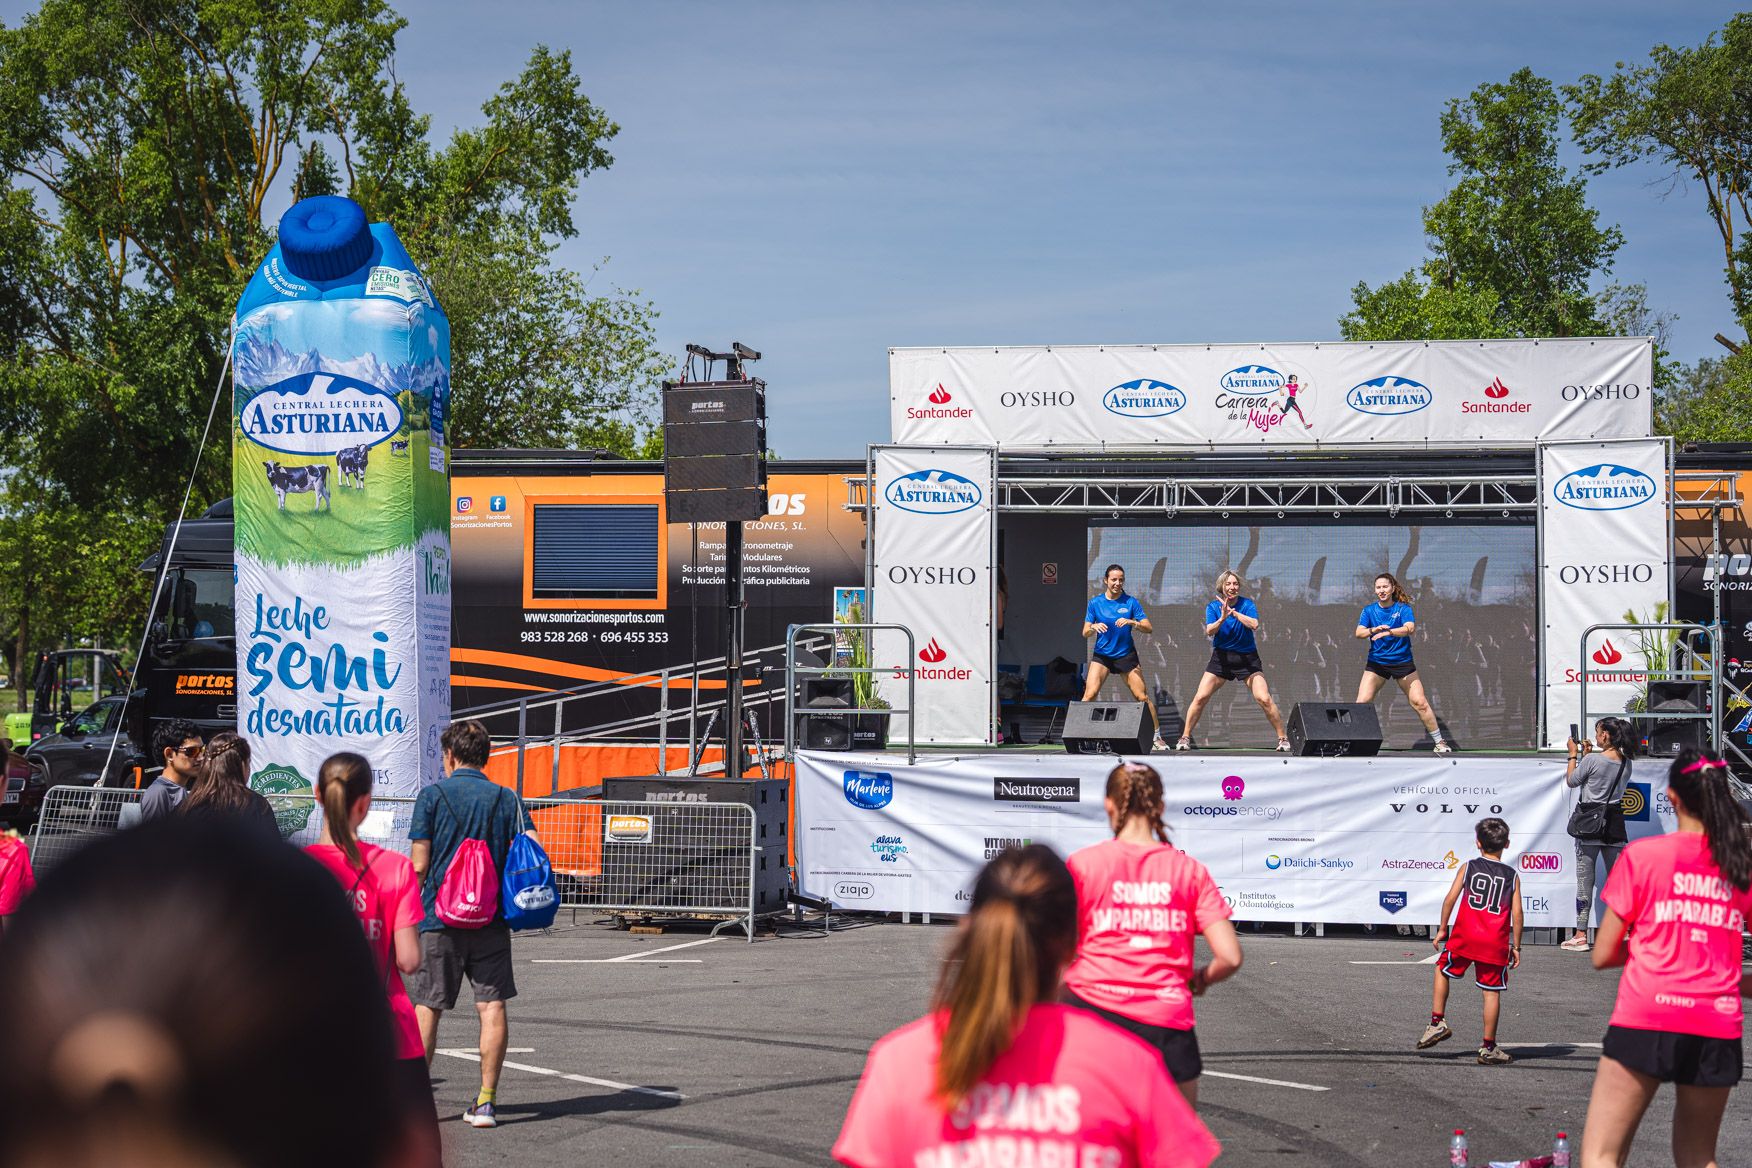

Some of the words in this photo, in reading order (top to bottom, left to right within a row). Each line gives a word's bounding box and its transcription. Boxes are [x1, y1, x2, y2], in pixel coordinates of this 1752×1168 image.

[372, 273, 400, 284] CERO
[1226, 376, 1280, 388] ASTURIANA
[1001, 391, 1075, 408] OYSHO
[1353, 391, 1425, 406] ASTURIANA
[1561, 384, 1640, 401] OYSHO
[273, 402, 325, 410] CENTRAL
[330, 400, 384, 409] LECHERA
[1110, 393, 1180, 408] ASTURIANA
[1215, 393, 1268, 409] Carrera
[1461, 401, 1532, 413] Santander
[249, 403, 391, 435] ASTURIANA
[907, 407, 974, 419] Santander
[1228, 410, 1238, 420] de
[1240, 410, 1247, 420] la
[1246, 407, 1288, 433] Mujer
[892, 484, 975, 503] ASTURIANA
[1561, 481, 1649, 499] ASTURIANA
[791, 522, 807, 530] SL.
[761, 563, 810, 573] Kilométricos
[888, 565, 976, 585] OYSHO
[1560, 563, 1653, 584] OYSHO
[765, 576, 810, 586] publicitaria
[250, 593, 330, 643] Leche
[523, 611, 665, 626] www.sonorizacionesportos.com
[520, 631, 542, 643] 983
[543, 631, 565, 643] 528
[567, 632, 589, 643] 268
[600, 632, 622, 643] 696
[624, 632, 645, 643] 455
[647, 632, 669, 643] 353
[247, 632, 402, 697] semi
[175, 674, 234, 689] portos
[247, 693, 409, 738] desnatada
[263, 787, 276, 795] SIN
[846, 779, 890, 800] Marlene
[1000, 781, 1074, 800] Neutrogena
[1393, 786, 1449, 795] VEHÍCULO
[1454, 787, 1498, 795] OFICIAL
[1183, 805, 1238, 818] octopus
[1239, 806, 1284, 821] energy
[1389, 803, 1503, 814] VOLVO
[611, 819, 648, 828] portos
[984, 838, 1022, 849] VITORIA
[881, 854, 897, 863] eus
[1284, 857, 1354, 871] Daiichi-Sankyo
[1381, 859, 1445, 870] AstraZeneca
[1521, 854, 1559, 870] COSMO
[1112, 880, 1172, 906] SOMOS
[1467, 872, 1506, 915] 91
[1673, 872, 1733, 902] SOMOS
[1239, 891, 1277, 900] Institutos
[1239, 900, 1295, 910] Odontológicos
